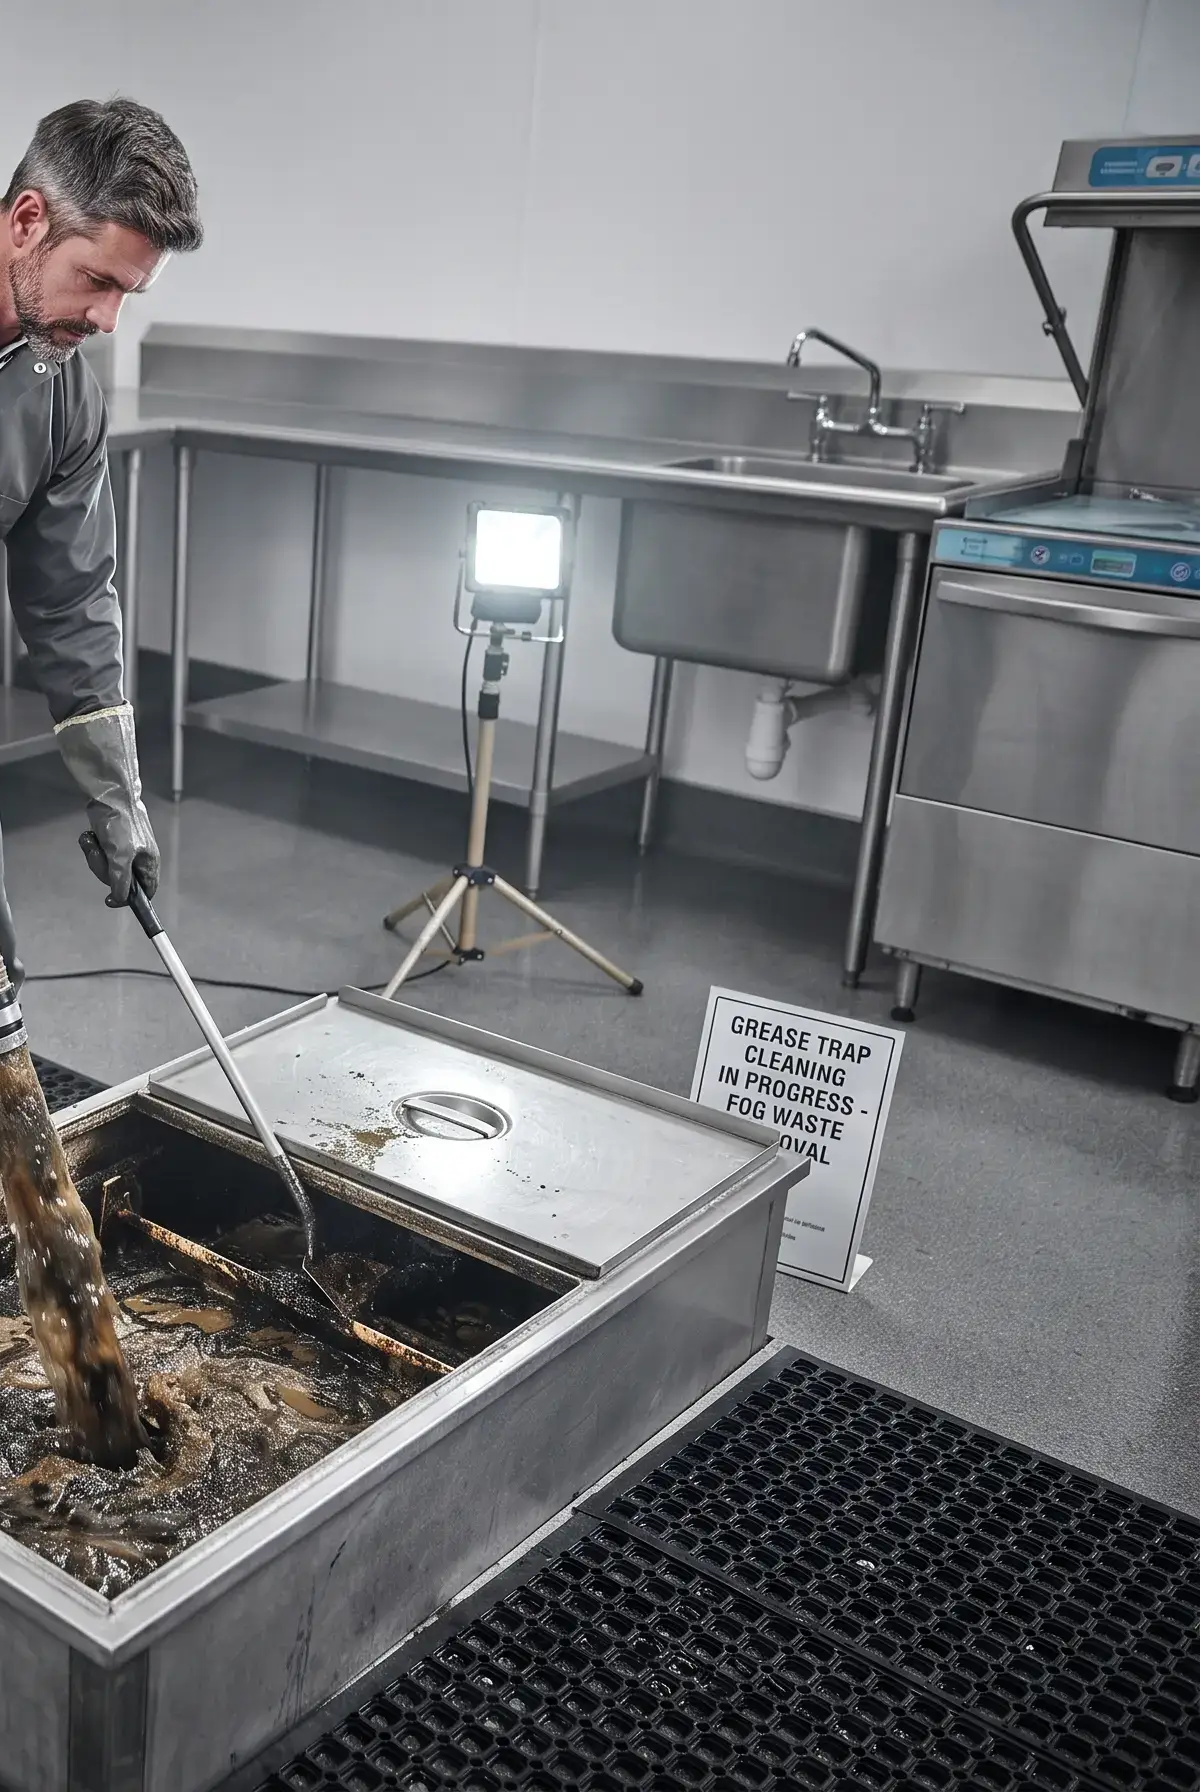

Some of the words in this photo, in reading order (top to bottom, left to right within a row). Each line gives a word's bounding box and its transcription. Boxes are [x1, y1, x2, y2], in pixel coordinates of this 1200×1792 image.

[731, 1015, 811, 1051] GREASE
[817, 1035, 872, 1065] TRAP
[744, 1044, 846, 1087] CLEANING
[718, 1065, 740, 1086] IN
[744, 1071, 854, 1116] PROGRESS
[726, 1093, 766, 1120] FOG
[773, 1105, 845, 1141] WASTE
[779, 1134, 830, 1166] OVAL
